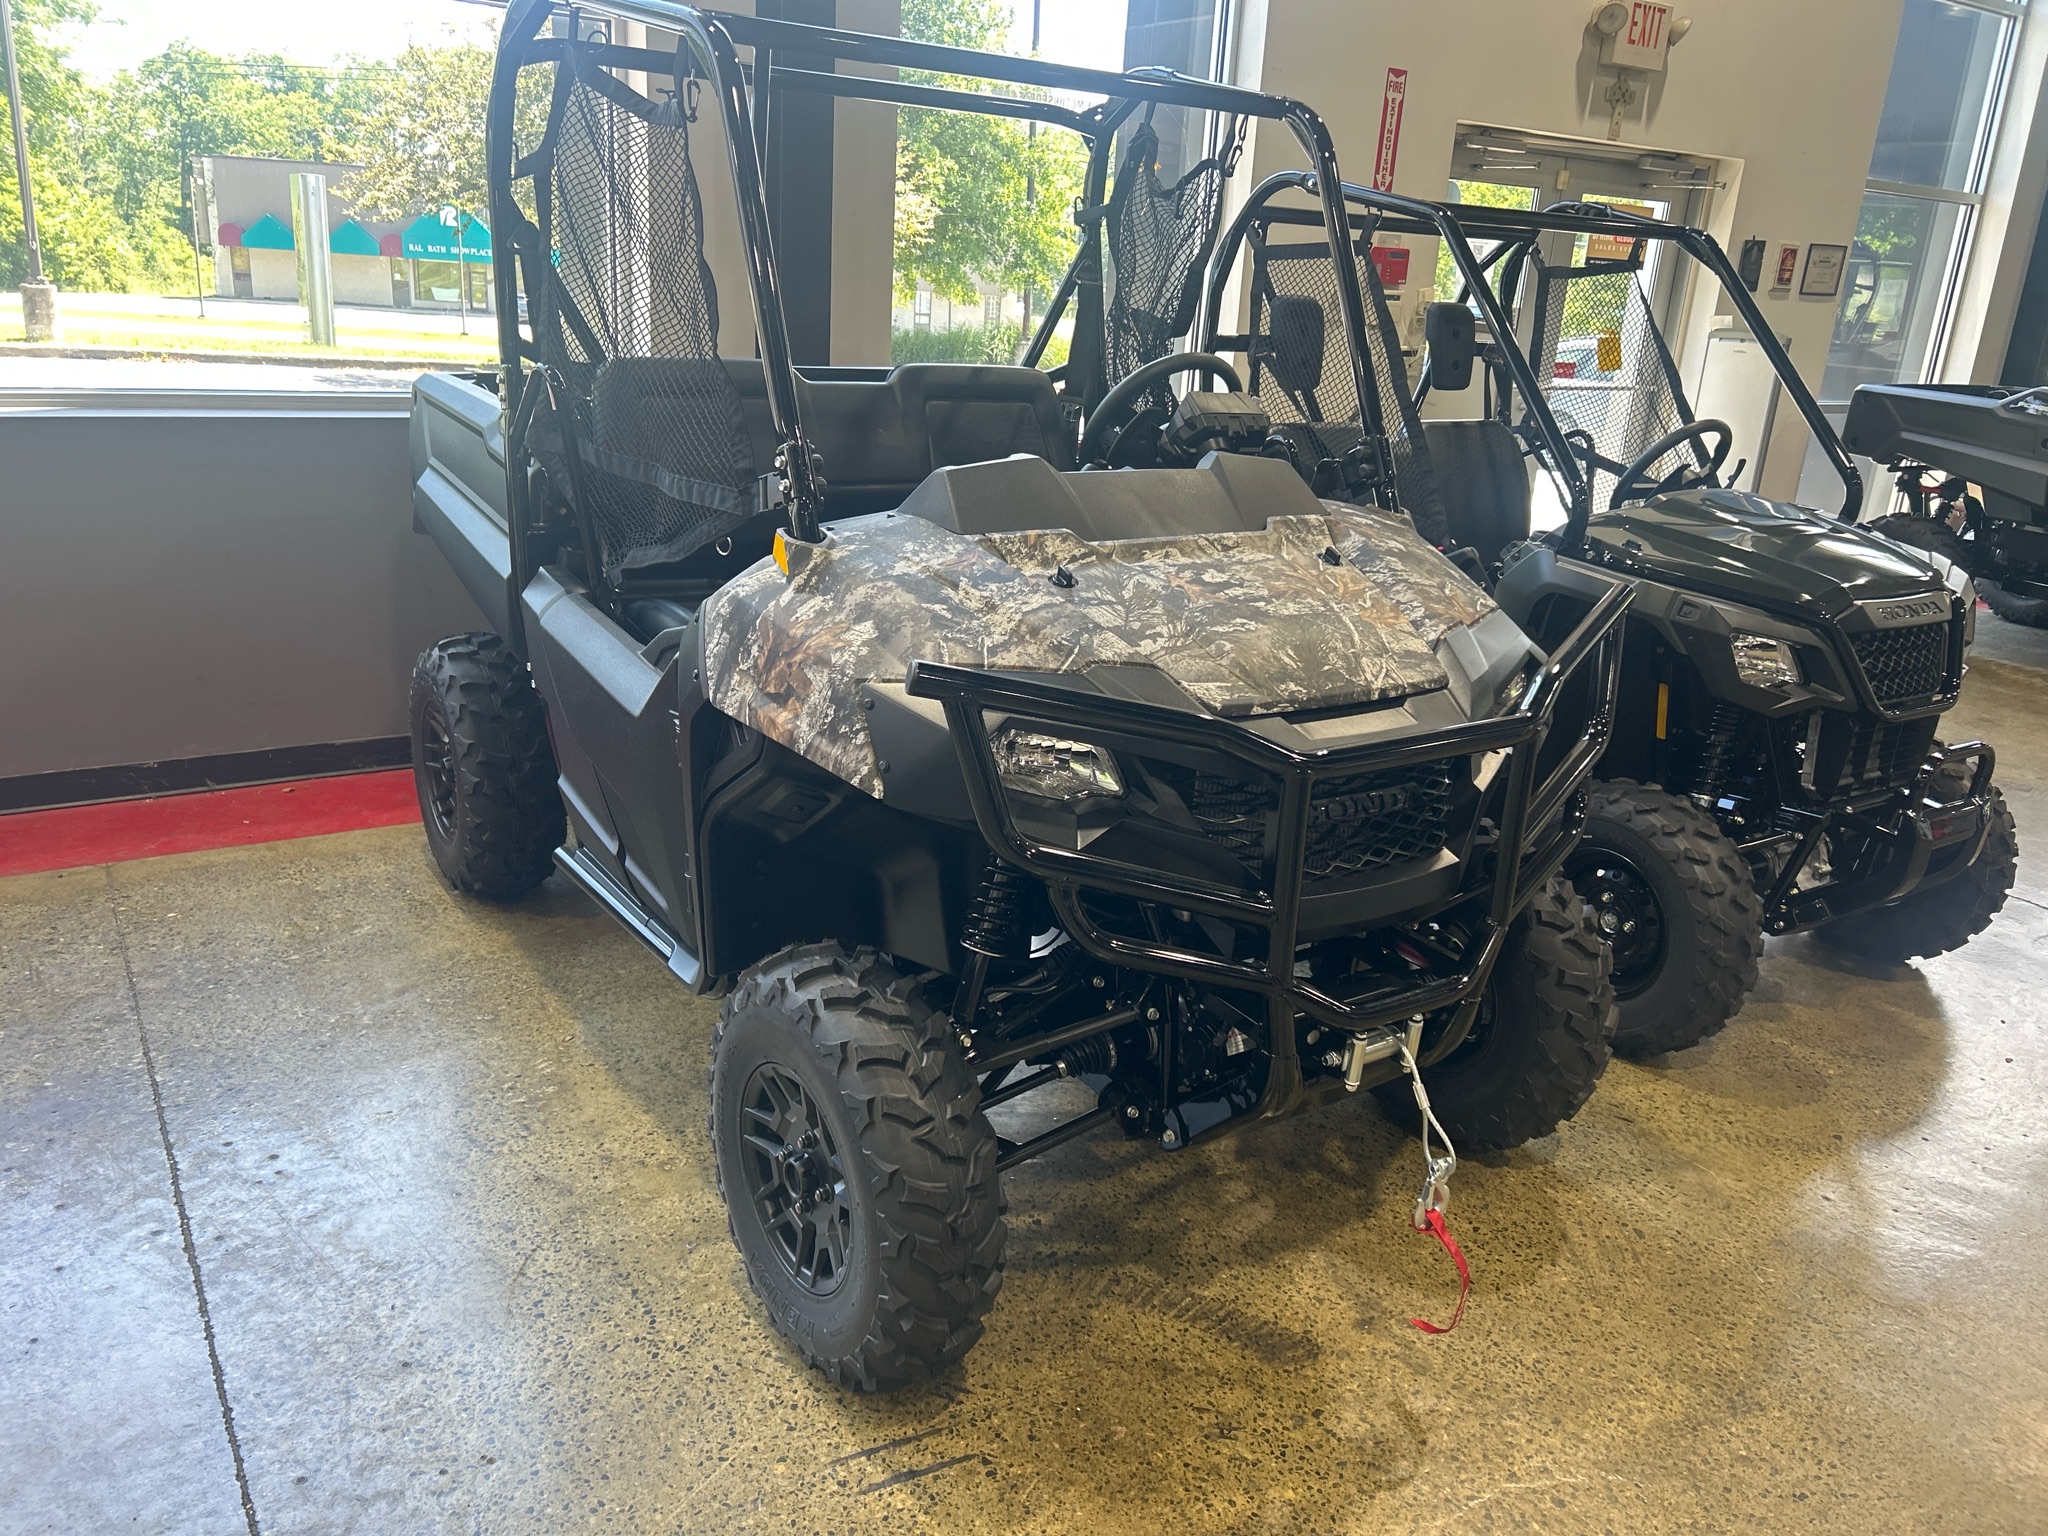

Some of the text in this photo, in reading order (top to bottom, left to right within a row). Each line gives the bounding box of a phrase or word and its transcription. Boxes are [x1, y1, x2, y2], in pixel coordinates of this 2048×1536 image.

[1628, 2, 1666, 49] EXIT
[1388, 79, 1403, 94] FIRE
[1380, 97, 1397, 188] EXTINGUISHER
[408, 244, 424, 252] RAL
[427, 245, 446, 253] BATH
[1877, 601, 1944, 621] HONDA
[748, 1250, 815, 1342] KENDA
